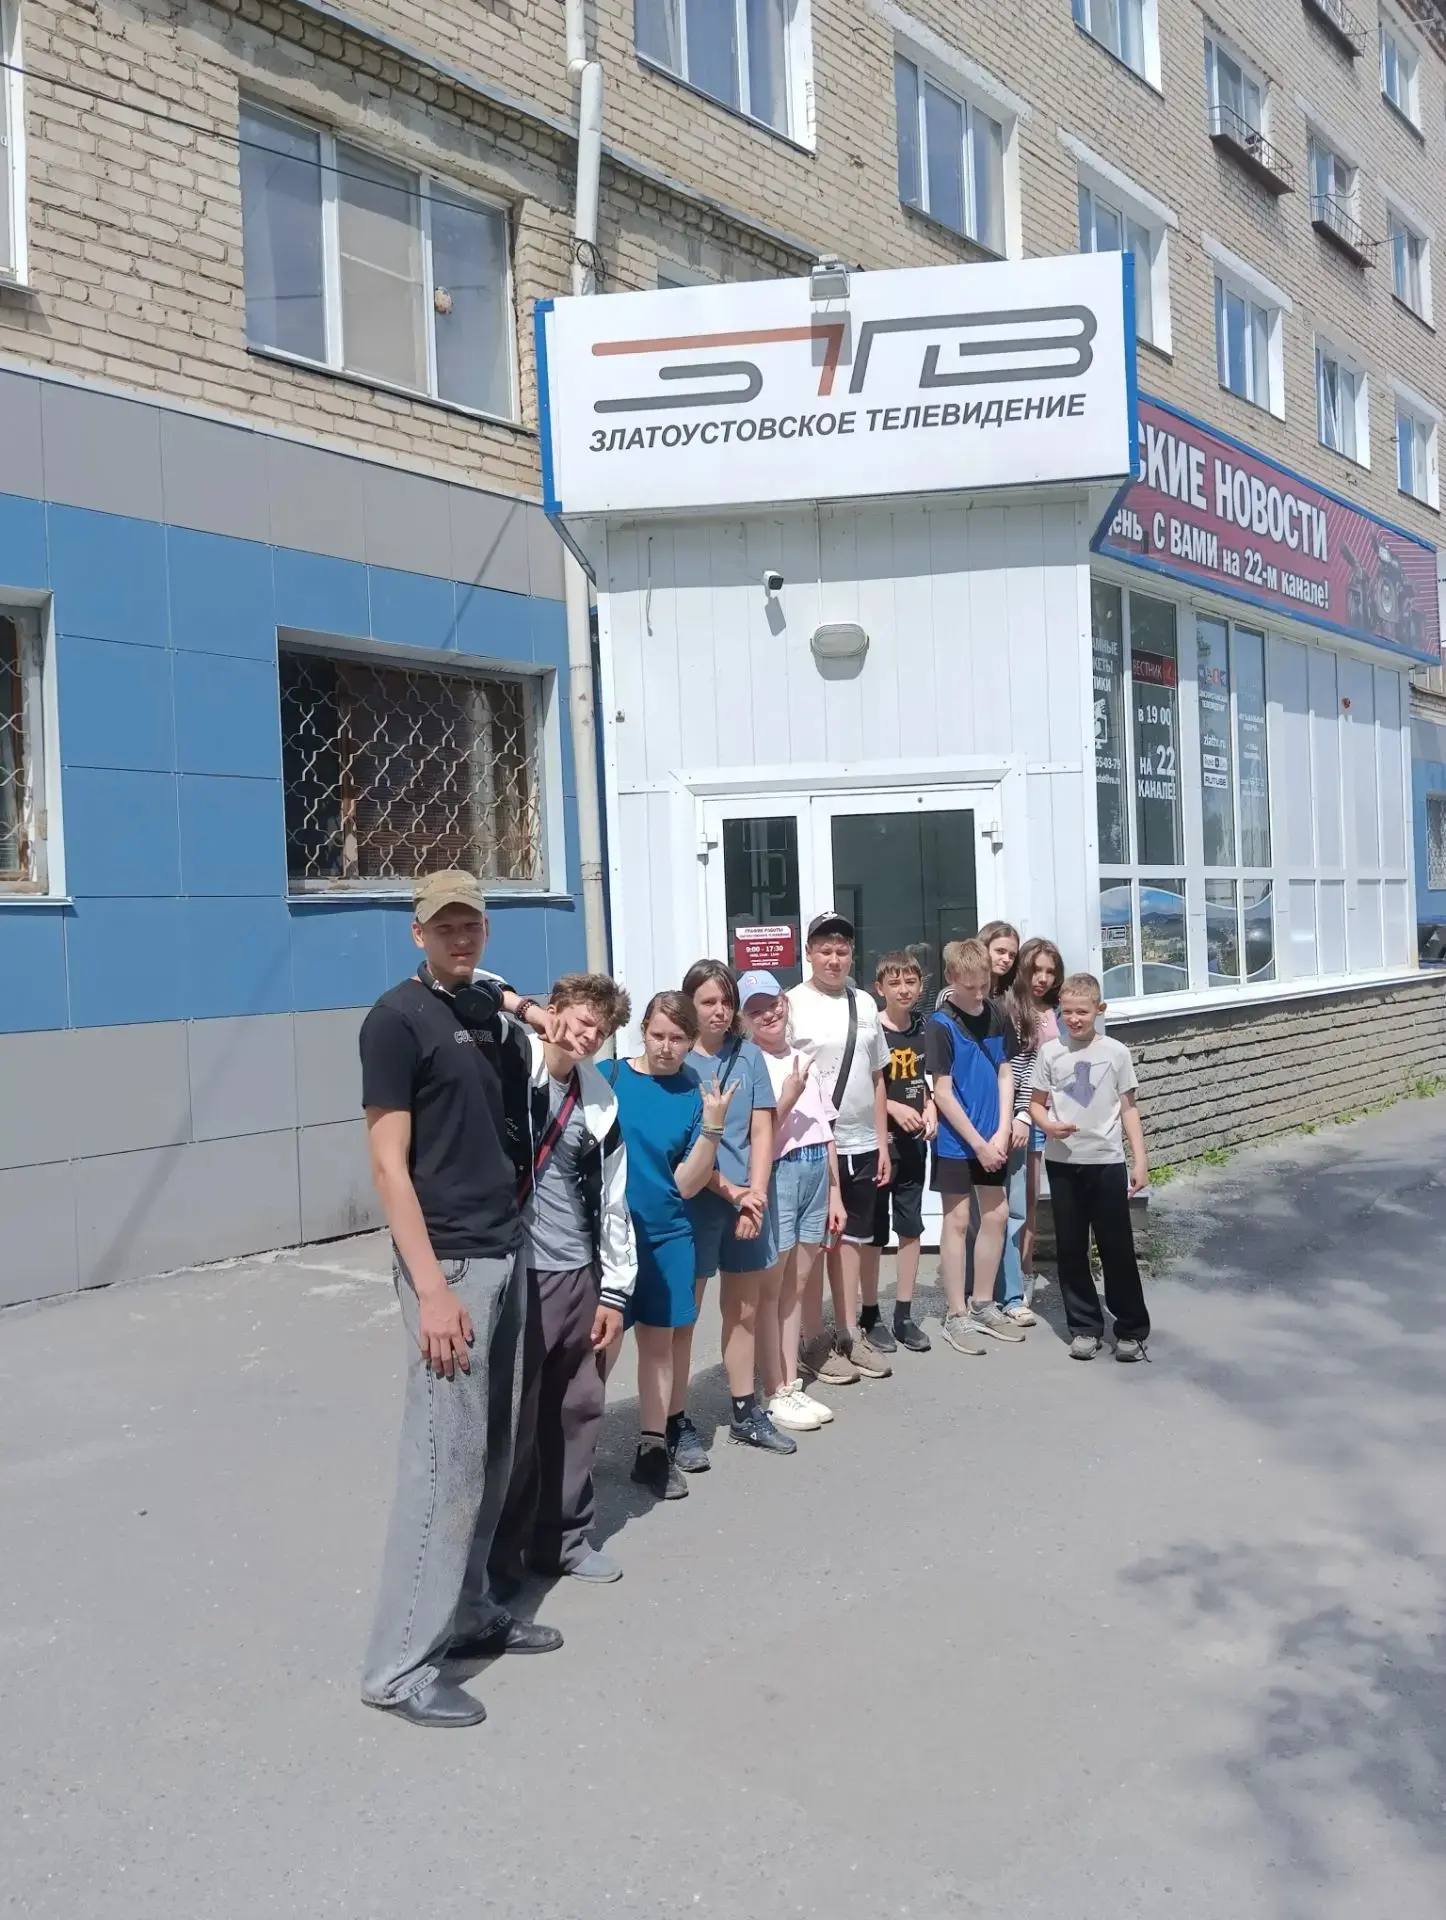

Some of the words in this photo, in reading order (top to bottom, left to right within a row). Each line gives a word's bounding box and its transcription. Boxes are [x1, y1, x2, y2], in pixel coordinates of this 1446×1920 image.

[589, 411, 855, 453] ЗЛАТОУСТОВСКОЕ
[866, 393, 1086, 434] ТЕЛЕВИДЕНИЕ
[1214, 458, 1328, 563] НОВОСТИ
[1108, 508, 1143, 542] ень
[1153, 512, 1166, 550] С
[1170, 518, 1219, 569] ВАМИ
[1222, 549, 1240, 576] на
[1244, 548, 1278, 591] 22-м
[1281, 572, 1329, 610] канале!
[1146, 705, 1158, 724] 19
[1160, 708, 1173, 726] 00
[1139, 756, 1152, 776] НА
[1156, 744, 1176, 777] 22
[1138, 778, 1176, 801] КАНАЛЕ!
[1204, 775, 1227, 787] RUTUBE
